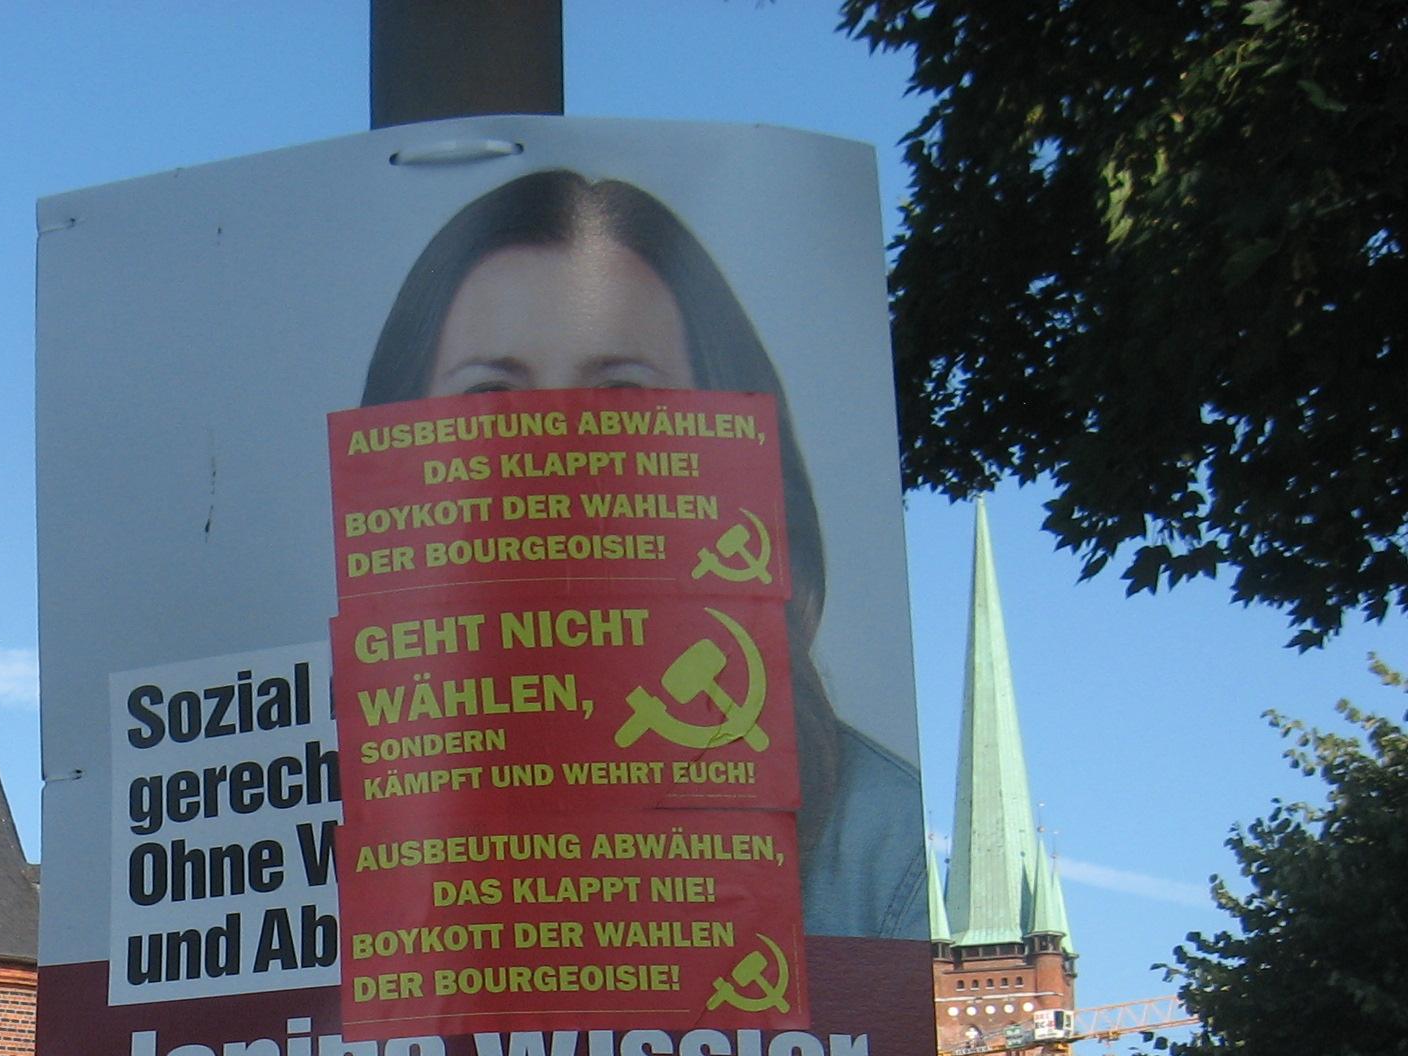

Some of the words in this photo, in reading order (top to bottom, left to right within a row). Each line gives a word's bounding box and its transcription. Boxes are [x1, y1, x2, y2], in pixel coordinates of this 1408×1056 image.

[347, 411, 567, 456] AUSBEUTUNG
[578, 406, 766, 446] ABWÄHLEN,
[424, 456, 492, 485] DAS
[501, 452, 626, 478] KLAPPT
[637, 451, 699, 477] NIE!
[345, 498, 492, 538] BOYKOTT
[502, 495, 571, 521] DER
[581, 494, 719, 520] WAHLEN
[347, 548, 414, 578] DER
[425, 536, 666, 568] BOURGEOISIE!
[354, 615, 485, 664] GEHT
[500, 609, 650, 650] NICHT
[127, 662, 311, 749] Sozial
[357, 673, 596, 727] WÄHLEN,
[361, 729, 506, 764] SONDERN
[364, 767, 483, 800] KÄMPFT
[492, 765, 554, 787] UND
[563, 762, 664, 785] WEHRT
[673, 762, 755, 785] EUCH!
[355, 834, 581, 872] AUSBEUTUNG
[592, 827, 784, 867] ABWÄHLEN,
[129, 839, 284, 906] Ohne
[433, 880, 503, 907] DAS
[512, 877, 640, 904] KLAPPT
[650, 877, 716, 902] NIE!
[127, 912, 241, 986] und
[352, 924, 504, 960] BOYKOTT
[514, 922, 584, 949] DER
[593, 922, 734, 947] WAHLEN
[353, 971, 423, 1003] DER
[434, 965, 680, 996] BOURGEOISIE!
